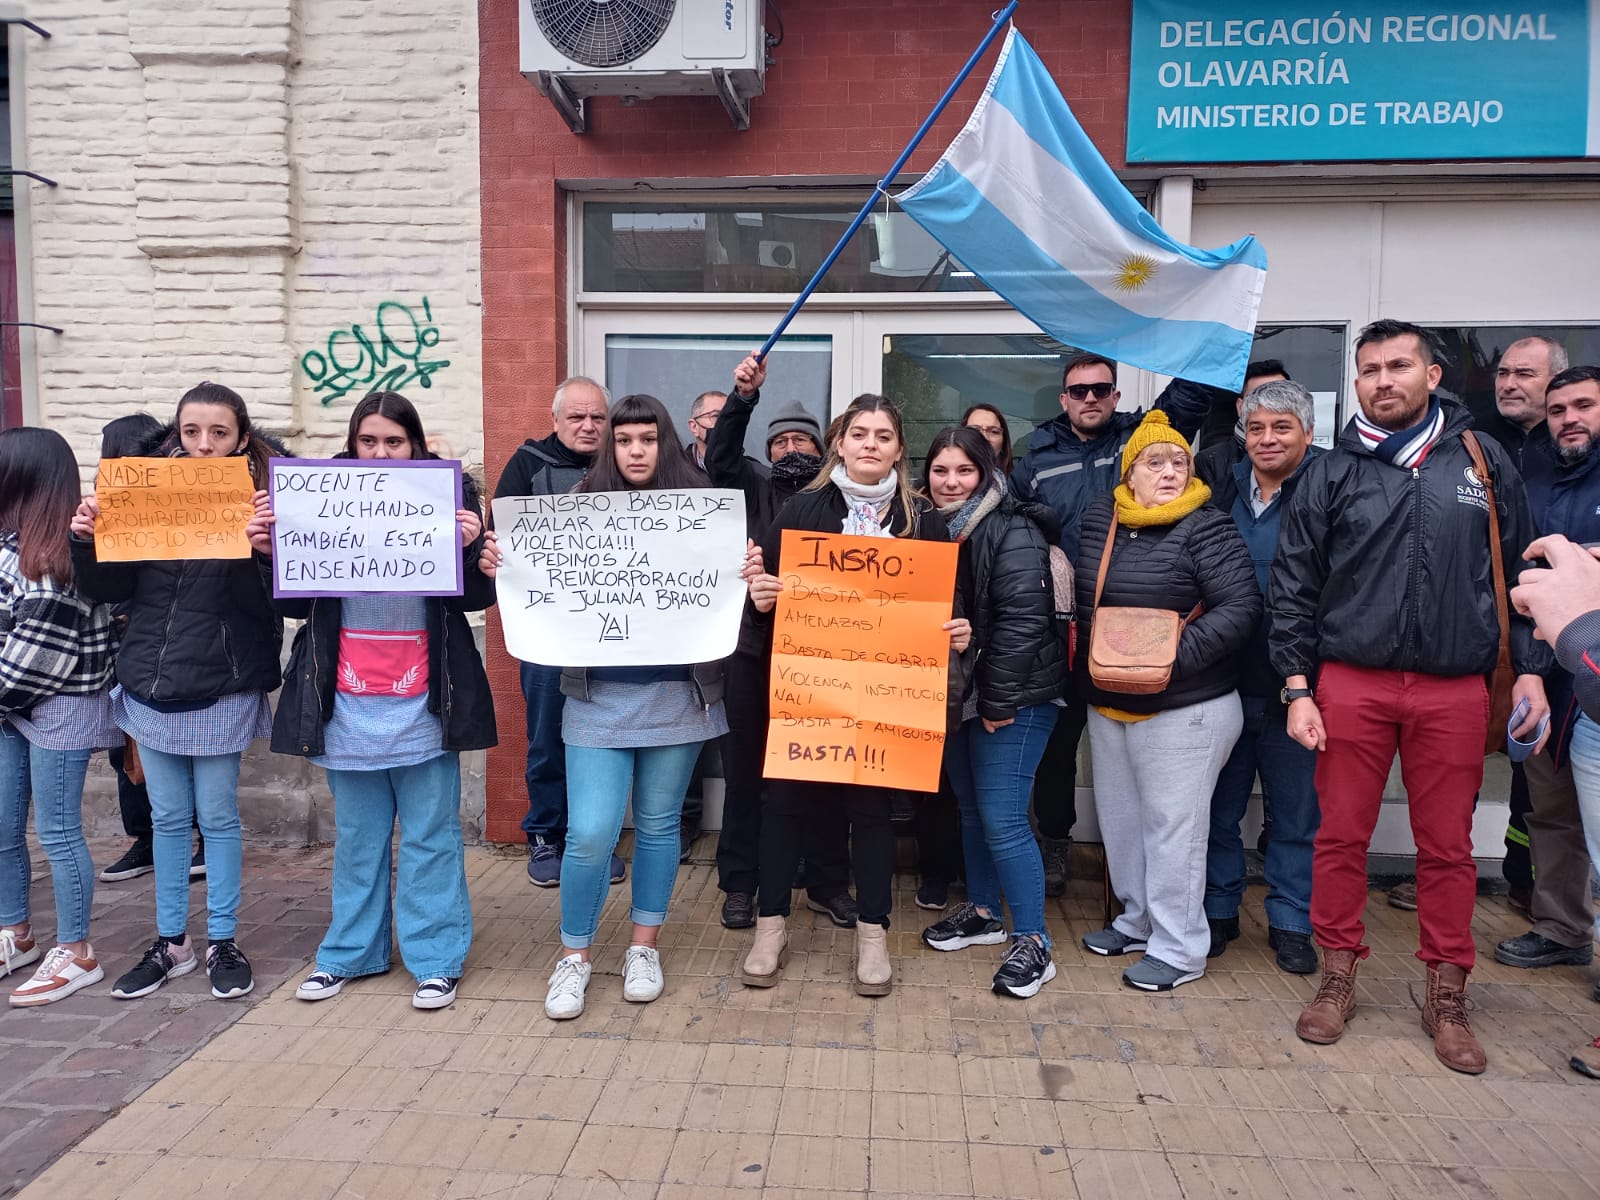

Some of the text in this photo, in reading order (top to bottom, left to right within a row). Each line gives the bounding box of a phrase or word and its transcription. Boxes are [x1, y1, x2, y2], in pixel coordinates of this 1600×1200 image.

[725, 0, 734, 31] tor
[1159, 10, 1557, 49] DELEGACIÓN REGIONAL
[1158, 52, 1350, 88] OLAVARRÍA
[1157, 100, 1504, 129] MINISTERIO DE TRABAJO
[168, 464, 236, 487] PUEDE
[275, 472, 390, 493] DOCENTE
[97, 490, 134, 511] SER
[626, 491, 696, 512] BASTA
[702, 496, 735, 516] DE
[1456, 484, 1489, 502] SADO
[317, 499, 434, 518] LUCHANDO
[511, 515, 708, 533] AVALAR ACTOS DE
[102, 530, 239, 549] OTROS LO SEAN
[384, 527, 437, 548] ESTÁ
[510, 532, 635, 552] VIOLENCIA!!!
[285, 555, 436, 581] ENSEÑANDO
[524, 551, 651, 568] PEDIMOS LA
[797, 536, 915, 579] INSRO:
[546, 568, 719, 590] REINCORPORACIÓN
[784, 574, 909, 607] BASTA DE
[525, 588, 711, 612] DE JULIANA BRAVO
[597, 612, 630, 643] YA!
[777, 634, 833, 661] BASTA
[841, 648, 868, 662] DE
[777, 664, 946, 702] VIOLENCIA INSTITUCIO
[778, 711, 945, 744] BASTA DE AMIGUISMO
